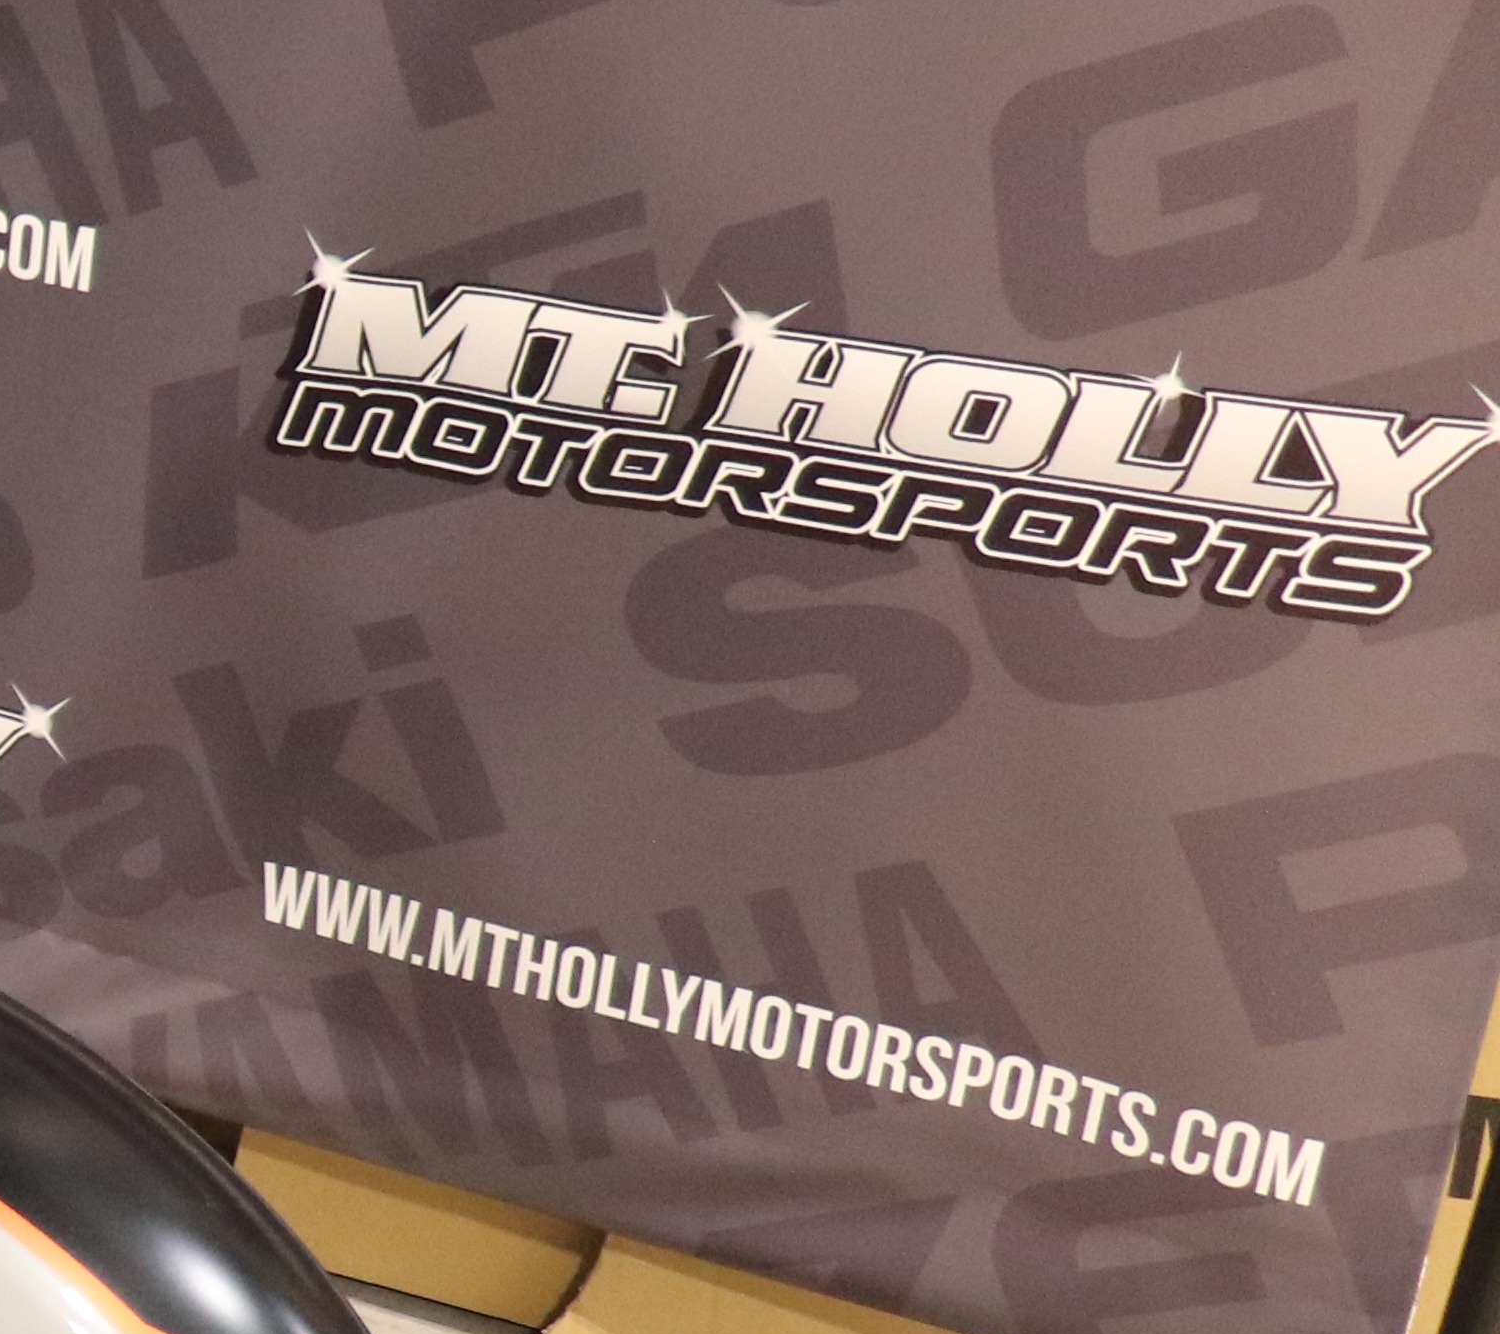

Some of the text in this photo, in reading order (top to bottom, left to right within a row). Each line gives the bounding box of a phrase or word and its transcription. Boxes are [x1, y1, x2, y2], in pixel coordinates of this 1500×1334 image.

[277, 381, 1433, 616] MOTORSPORTS
[298, 270, 1496, 536] MT. HOLLY
[262, 861, 1326, 1208] WWW.MTHOLLYMOTORSPORTS.COM
